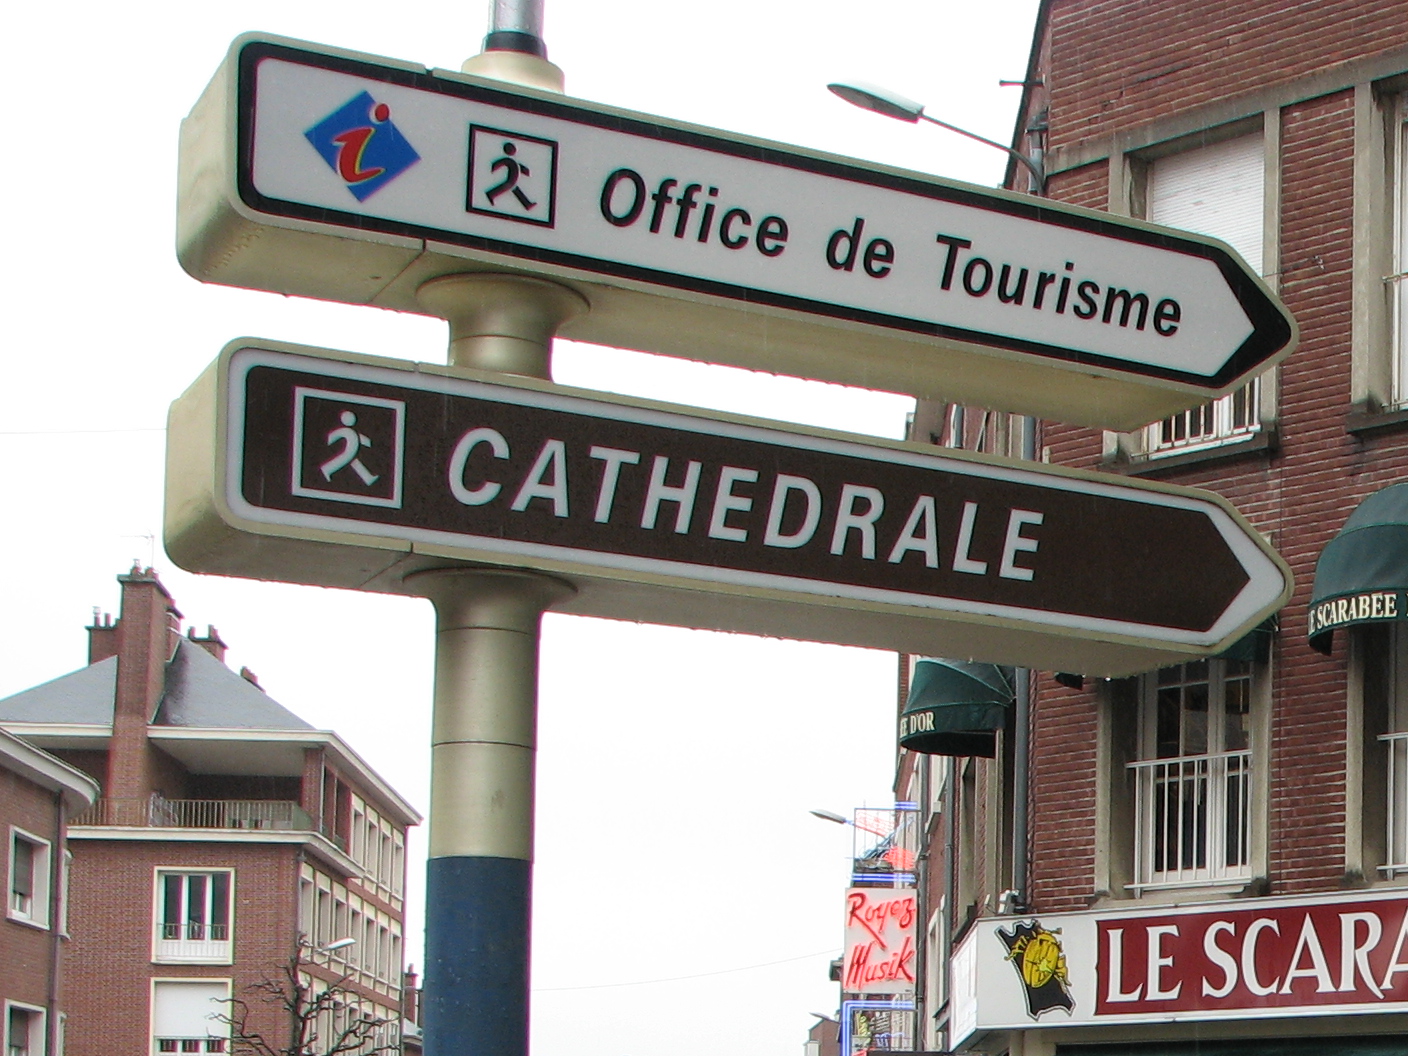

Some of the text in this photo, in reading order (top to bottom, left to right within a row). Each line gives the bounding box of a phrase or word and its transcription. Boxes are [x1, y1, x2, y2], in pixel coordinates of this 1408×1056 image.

[600, 167, 1181, 337] Office de Tourisme
[447, 426, 1045, 582] CATHEDRALE
[910, 711, 935, 735] D'OR
[847, 891, 916, 951] Royez
[845, 936, 914, 990] Musik
[1106, 925, 1183, 1003] LE
